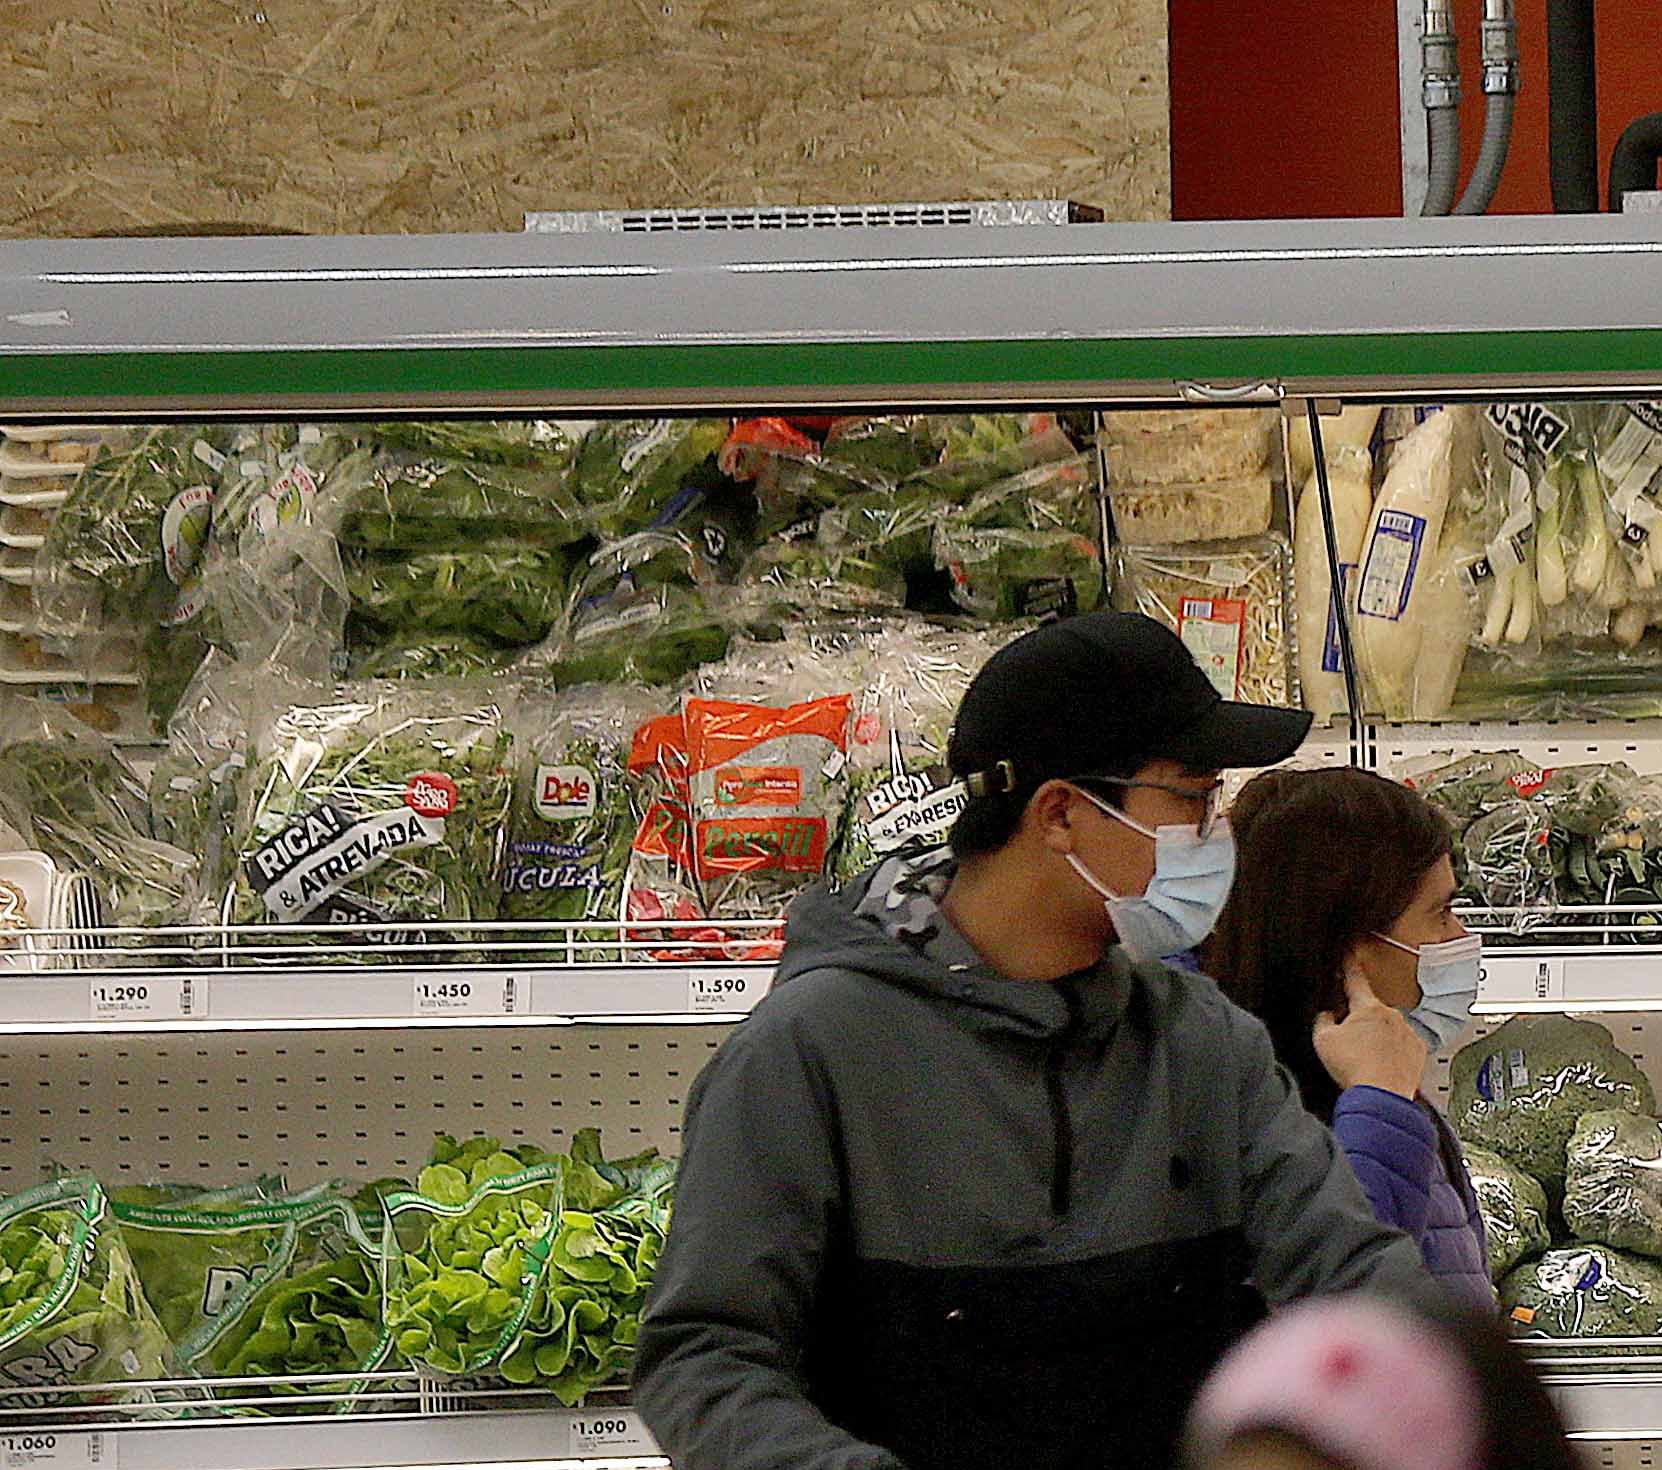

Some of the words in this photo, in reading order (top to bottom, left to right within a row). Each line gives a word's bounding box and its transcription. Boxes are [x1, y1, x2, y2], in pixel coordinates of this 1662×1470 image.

[543, 775, 591, 802] Dole
[866, 772, 935, 816] RICO!
[255, 805, 342, 882] RICA!
[279, 886, 297, 910] &
[298, 815, 428, 907] ATREVIDA
[503, 860, 601, 892] ÚCULA
